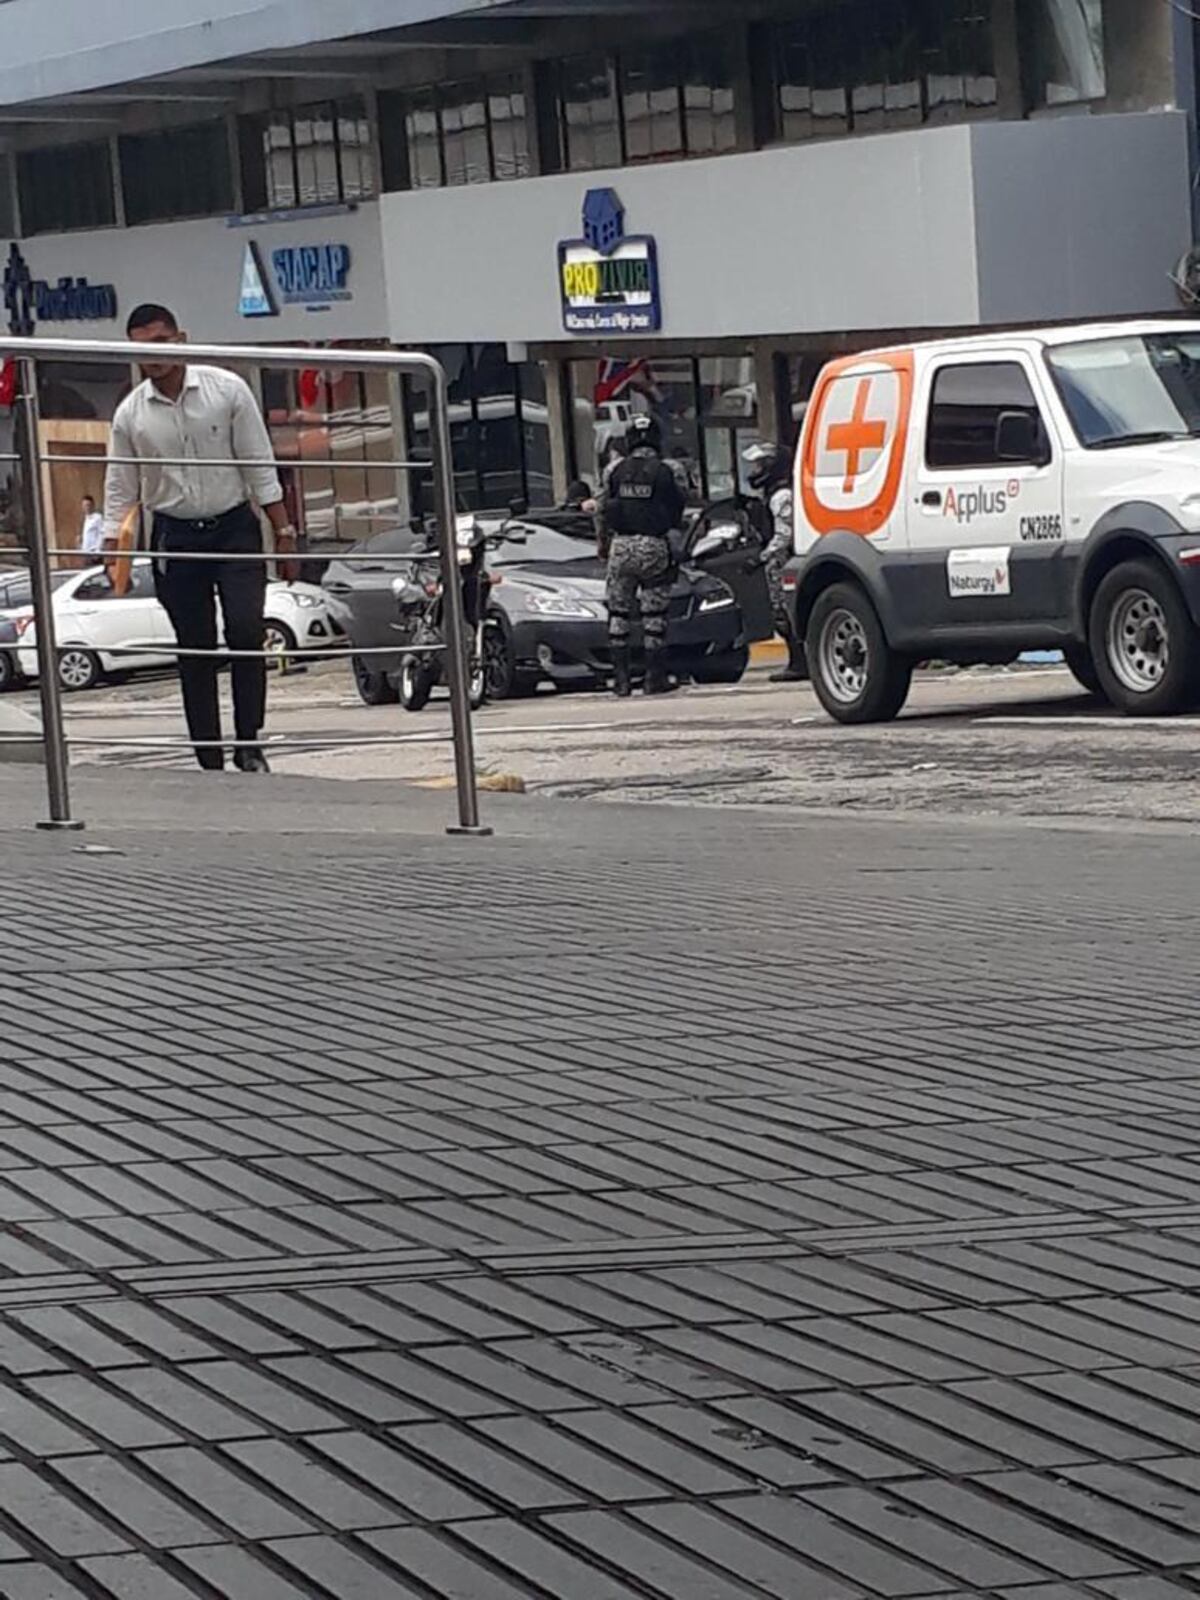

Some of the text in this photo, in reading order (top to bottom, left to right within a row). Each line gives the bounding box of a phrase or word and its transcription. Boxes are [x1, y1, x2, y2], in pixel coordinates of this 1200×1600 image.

[273, 244, 350, 292] SIACAP
[563, 259, 650, 297] PROVIVIR
[943, 485, 1006, 523] Applus
[951, 575, 996, 592] Naturgy
